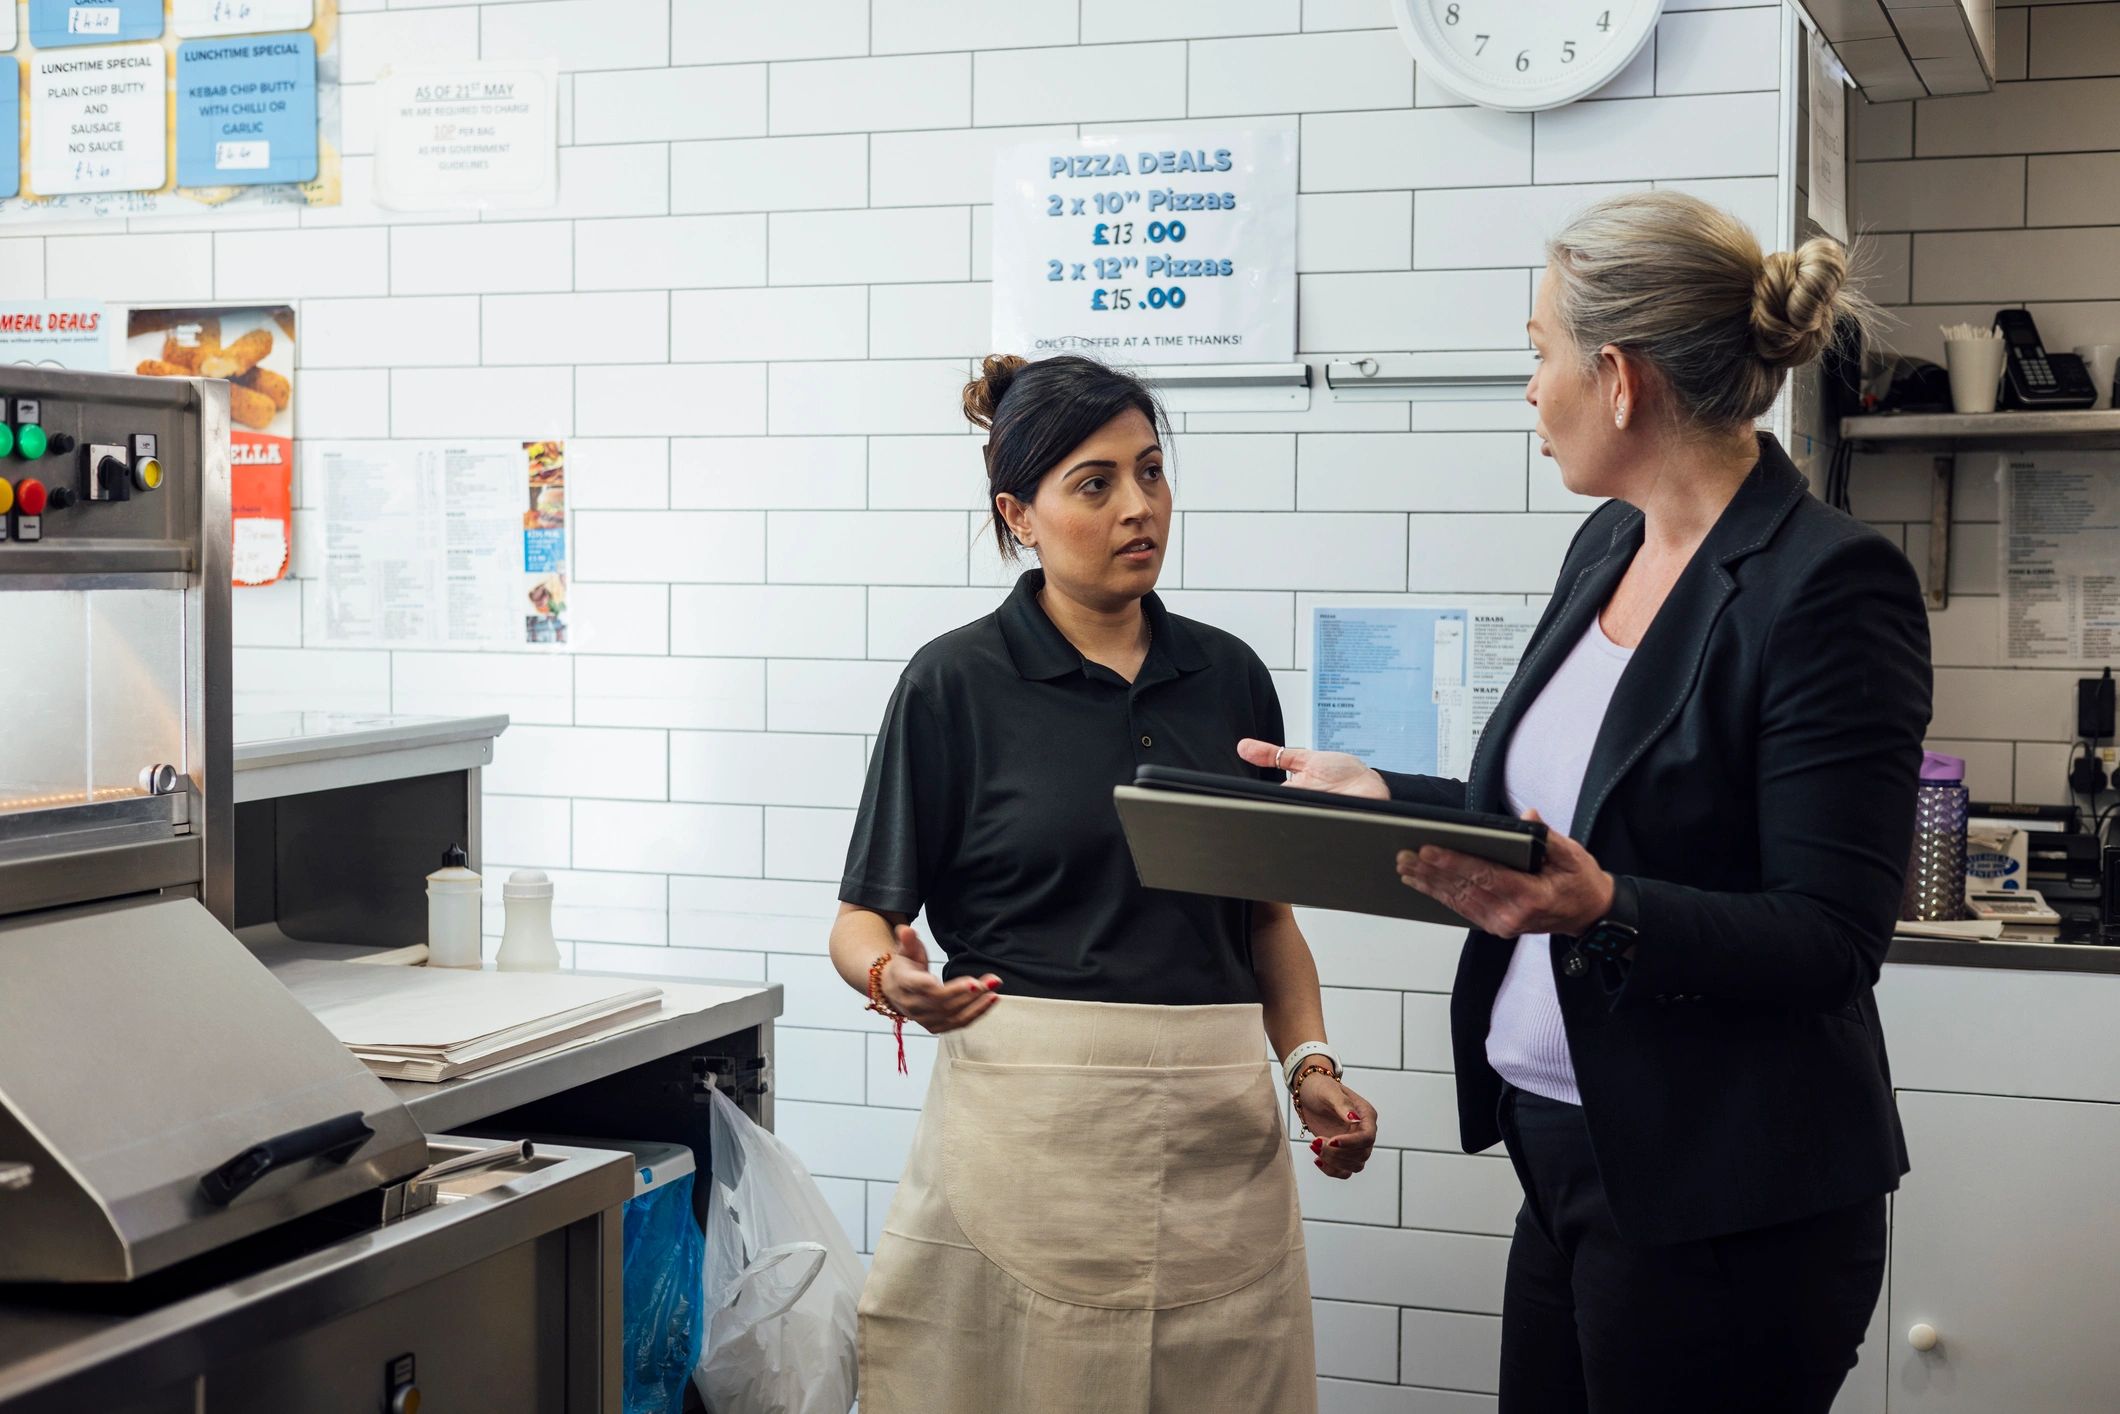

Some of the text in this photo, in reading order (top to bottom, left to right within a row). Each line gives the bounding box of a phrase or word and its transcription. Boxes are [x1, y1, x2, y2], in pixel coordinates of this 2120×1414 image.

[1446, 3, 1460, 26] 8
[1596, 10, 1610, 32] 4
[184, 43, 300, 62] LUNCHTIME SPECIAL
[1475, 34, 1491, 57] 7
[1561, 41, 1576, 64] 5
[42, 57, 152, 74] LUNCHTIME SPECIAL
[1515, 50, 1530, 72] 6
[48, 82, 144, 98] PLAIN CHIP BUTTY
[189, 80, 296, 98] KEBAB CHIP BUTTY
[415, 86, 431, 99] AS
[434, 85, 451, 98] OF
[484, 84, 513, 96] MAY
[84, 103, 108, 114] AND
[199, 100, 287, 117] WITH CHILLI OR
[71, 122, 121, 135] SAUSAGE
[222, 121, 263, 135] GARLIC
[69, 140, 123, 153] NO SAUCE
[1051, 150, 1233, 180] PIZZA DEALS
[1048, 195, 1064, 217] 2
[1071, 198, 1086, 216] x
[1150, 189, 1237, 213] Pizzas
[1048, 259, 1064, 282] 2
[1071, 263, 1086, 281] x
[1148, 254, 1234, 279] Pizzas
[0, 312, 99, 333] MEAL DEALS
[1035, 339, 1066, 349] ONLY
[1080, 337, 1119, 347] OFFER
[1123, 336, 1138, 347] AT
[1142, 336, 1151, 346] A
[1154, 335, 1183, 346] TIME
[1188, 335, 1242, 345] THANKS!
